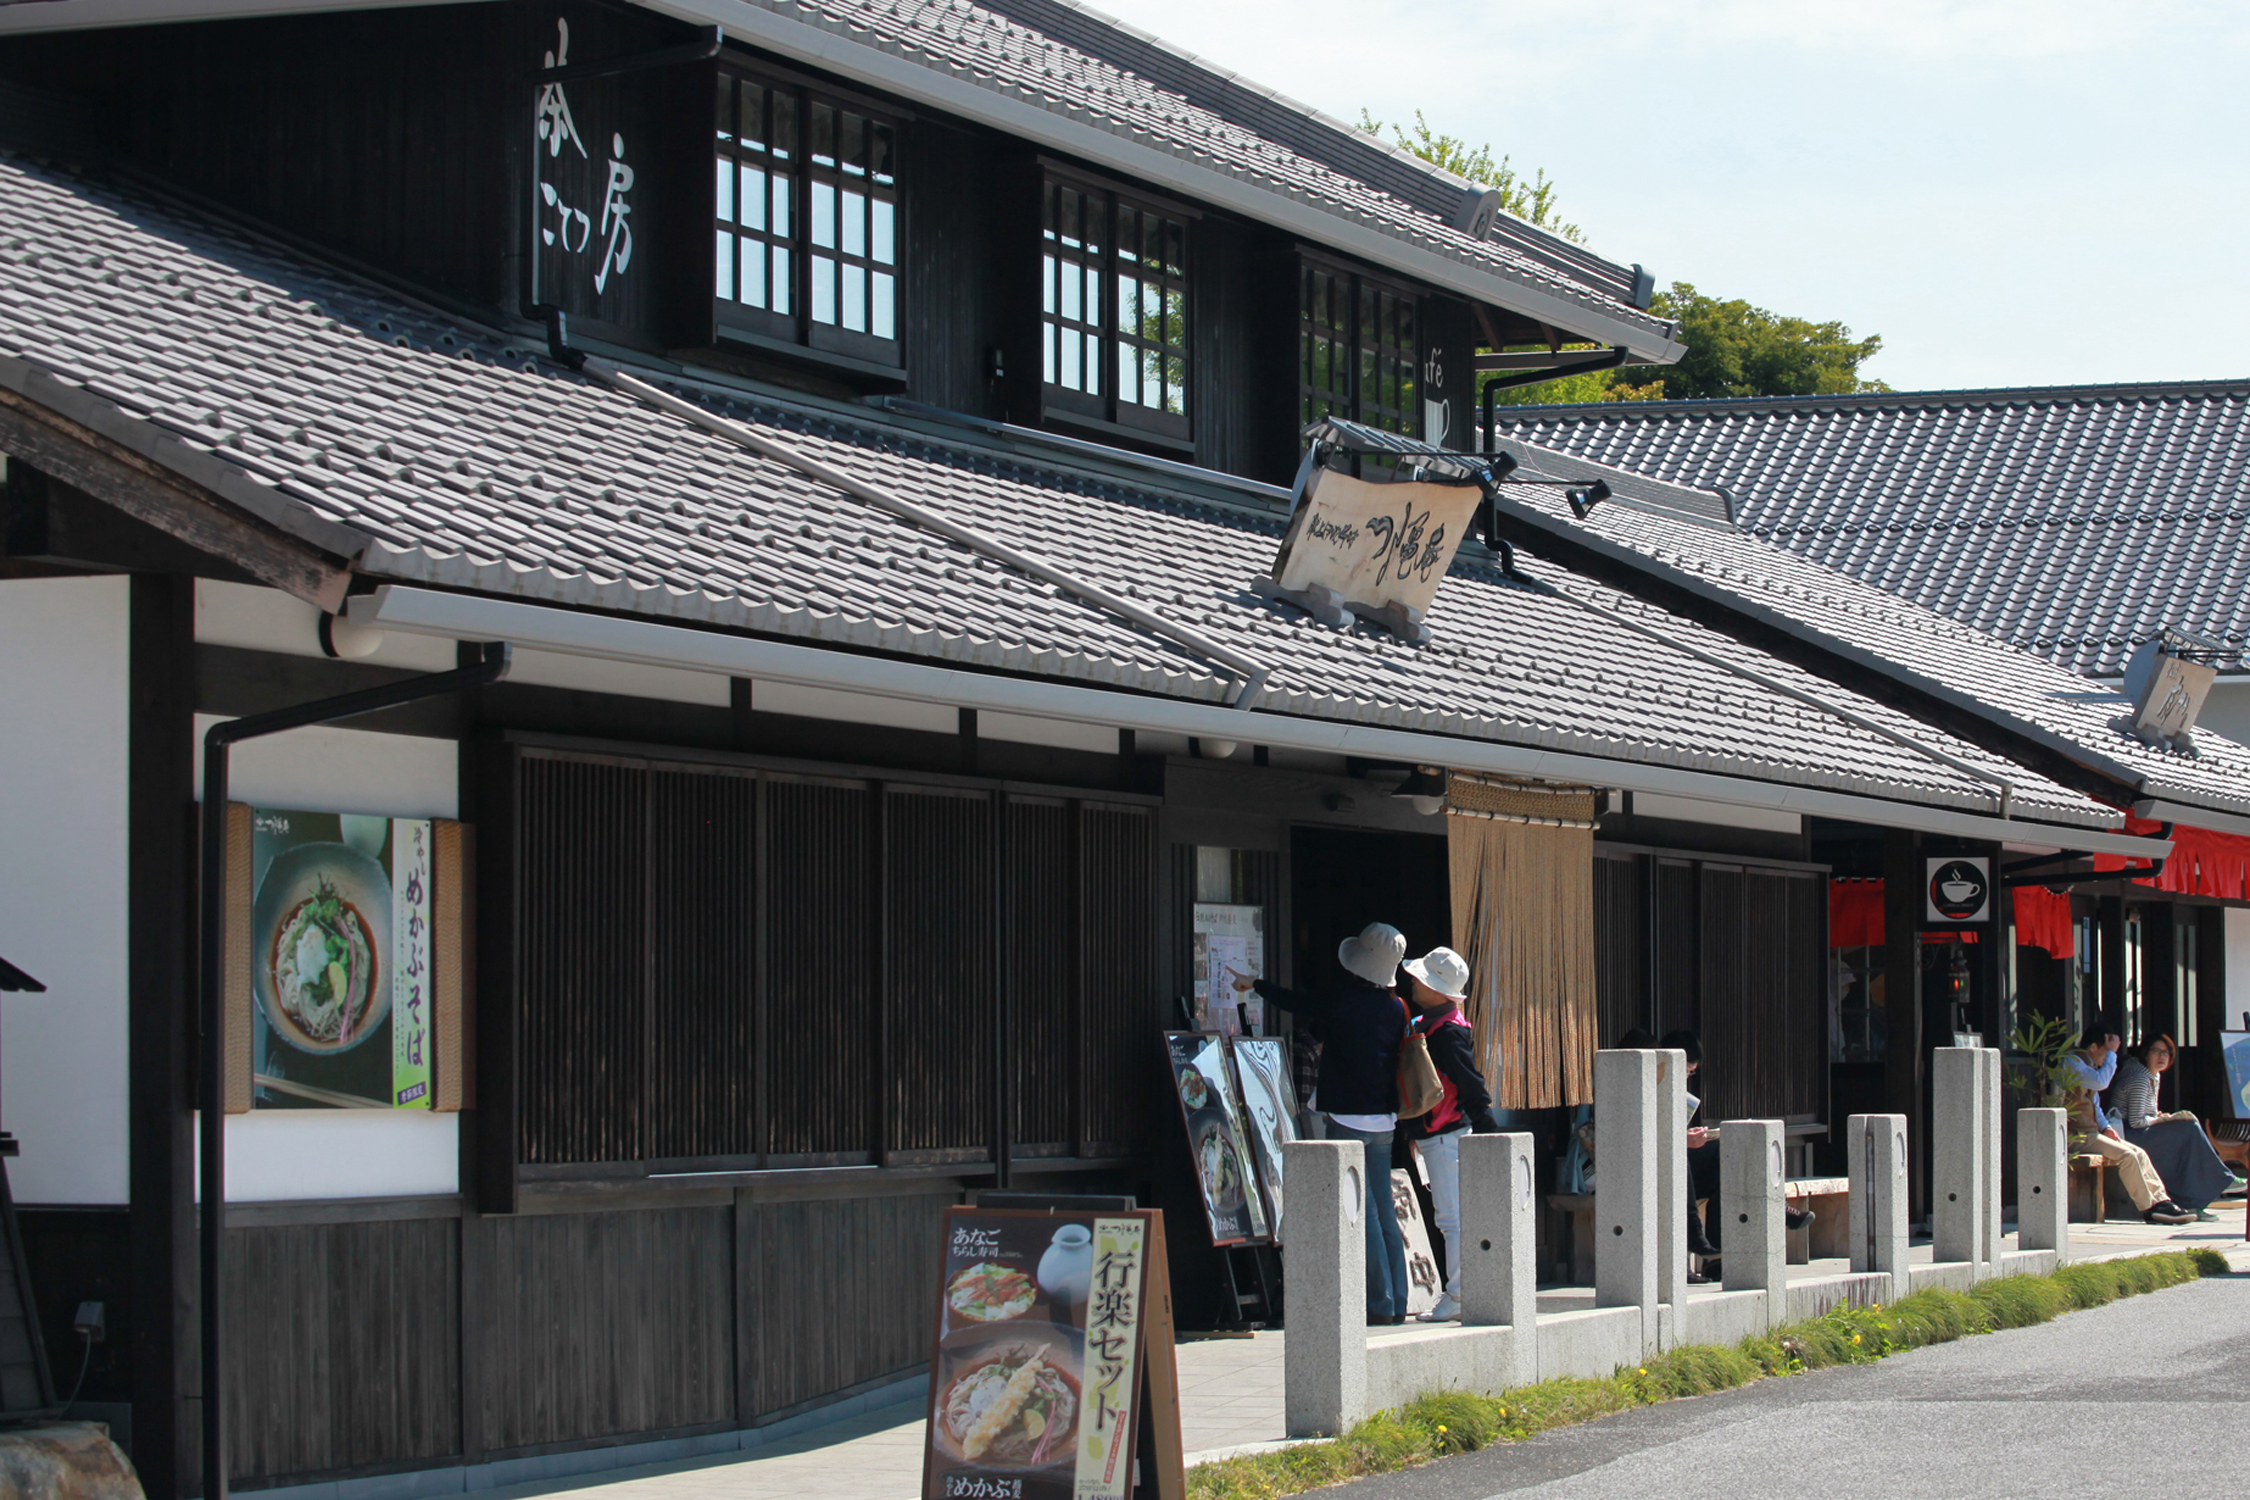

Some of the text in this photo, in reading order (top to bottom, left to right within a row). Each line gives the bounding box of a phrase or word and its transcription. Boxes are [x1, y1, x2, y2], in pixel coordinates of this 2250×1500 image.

[412, 827, 427, 876] 冷やし
[406, 867, 426, 1066] めかぶそば
[952, 1246, 999, 1258] ちらし寿司
[953, 1227, 1001, 1246] あなご
[1090, 1251, 1134, 1429] 行楽セット
[953, 1477, 1011, 1498] めかぶ
